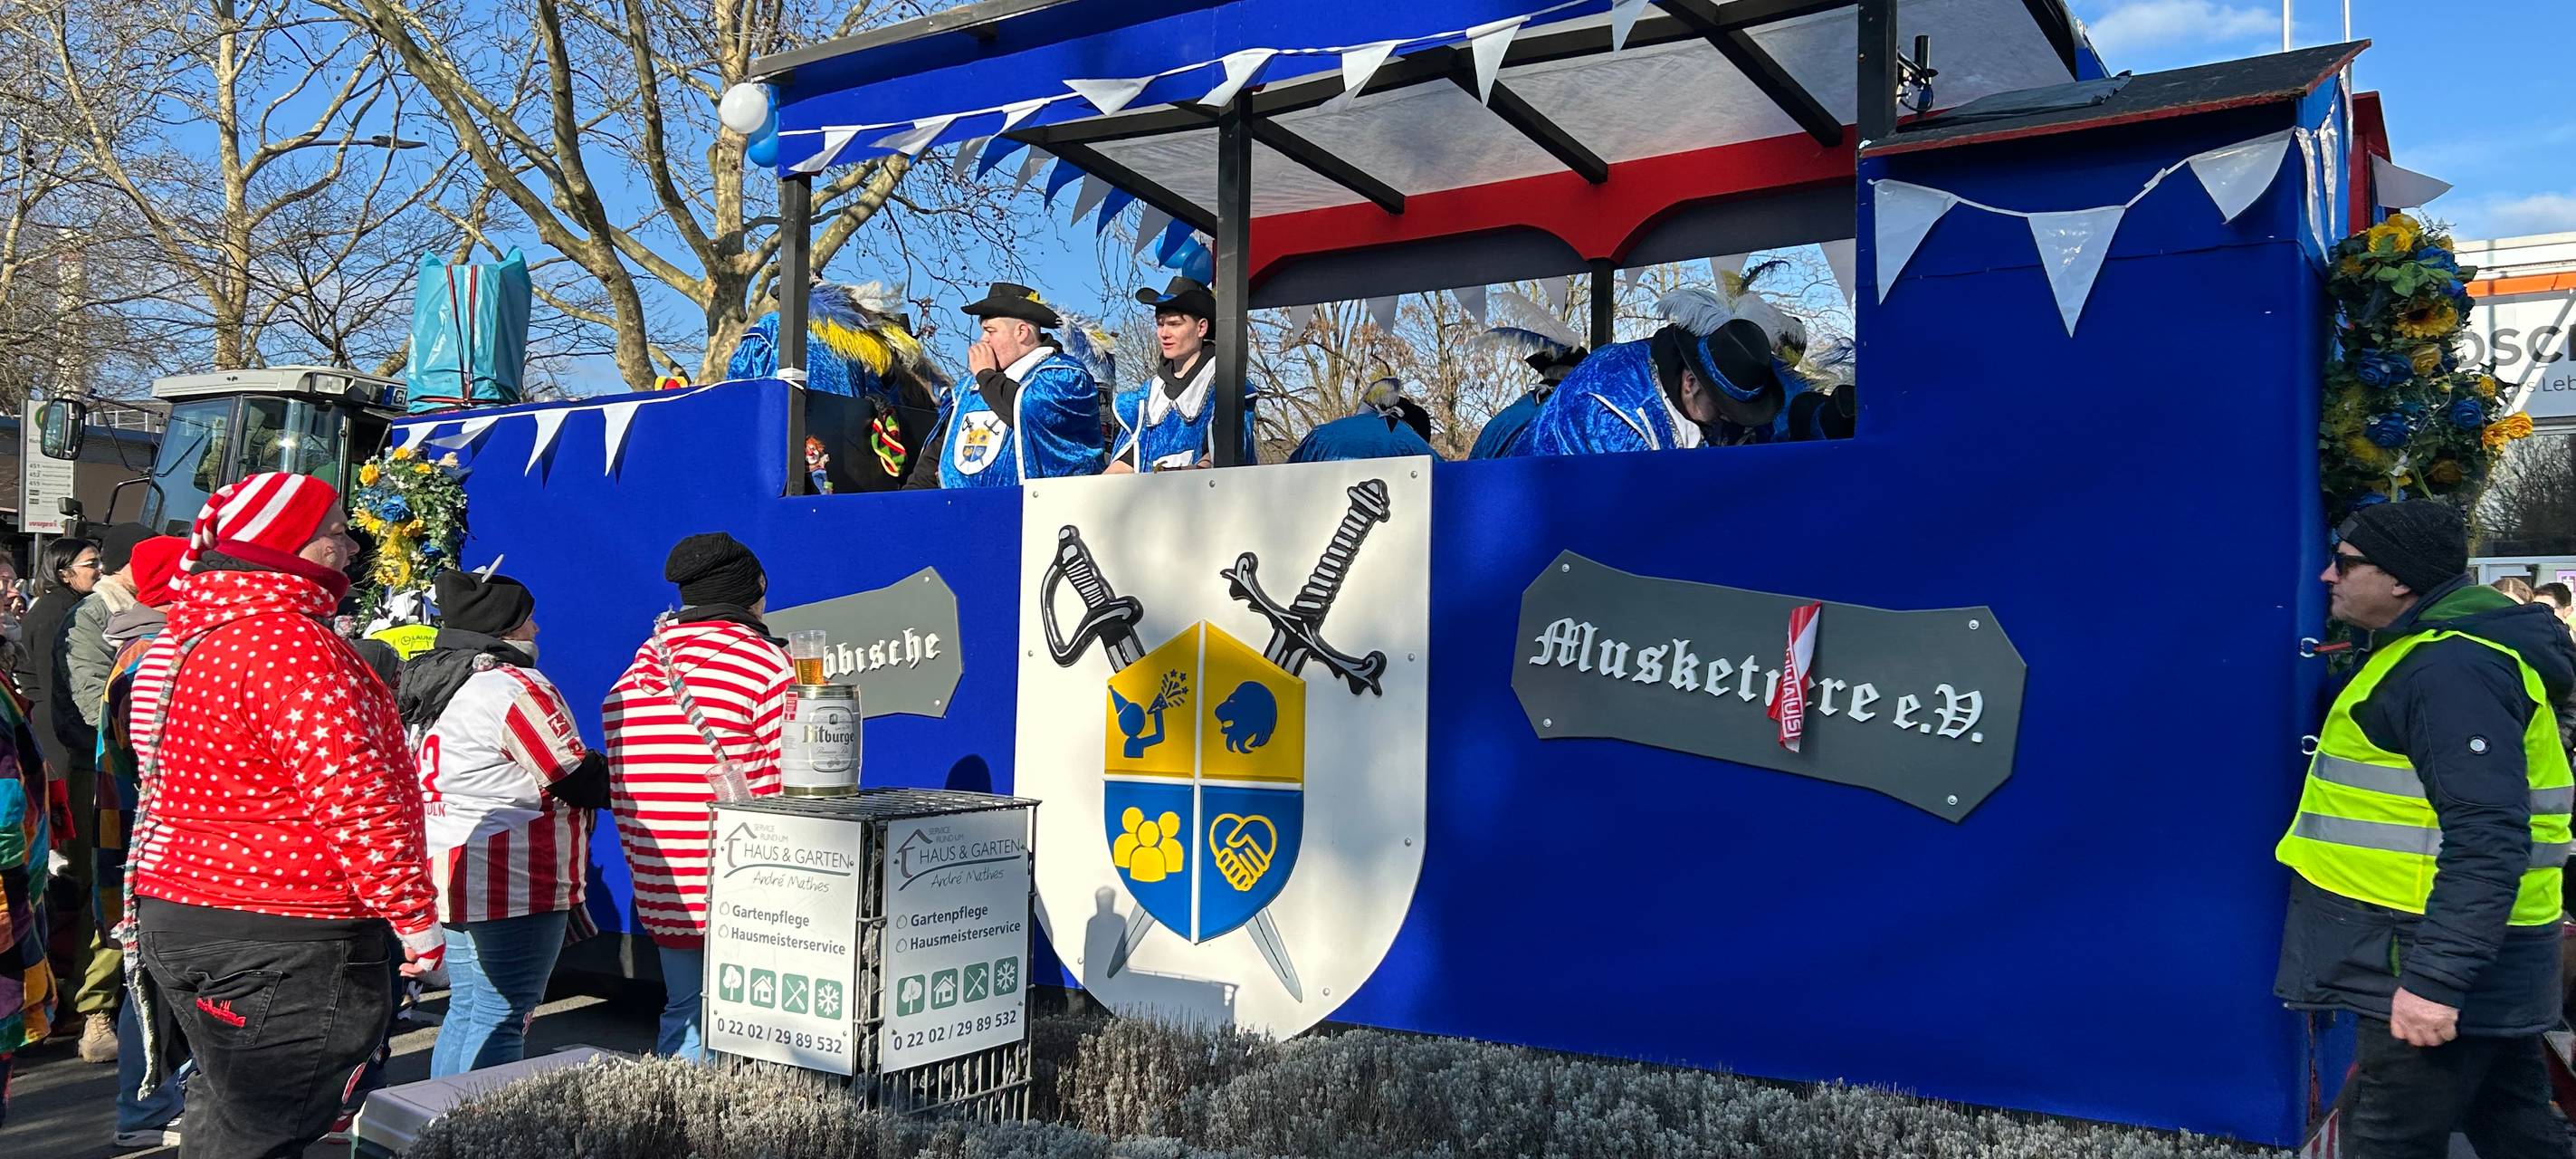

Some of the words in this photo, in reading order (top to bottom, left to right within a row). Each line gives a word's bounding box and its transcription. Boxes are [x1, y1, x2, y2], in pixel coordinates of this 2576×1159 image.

[2542, 374, 2576, 392] Leb
[823, 627, 941, 679] bbische
[1529, 617, 1882, 723] Musketire
[1893, 683, 1984, 744] e.V.
[802, 724, 854, 745] Bitburge
[744, 843, 779, 861] HAUS
[782, 848, 791, 863] &
[795, 848, 850, 869] GARTEN
[920, 845, 956, 865] HAUS
[959, 844, 968, 859] &
[971, 838, 1020, 857] GARTEN
[752, 871, 785, 887] André
[930, 871, 963, 888] André
[732, 905, 810, 929] Gartenpflege
[911, 905, 988, 927] Gartenpflege
[731, 926, 846, 955] Hausmeisterservice
[910, 921, 1021, 950] Hausmeisterservice
[717, 1018, 725, 1032] 0
[729, 1020, 743, 1036] 22
[748, 1023, 763, 1039] 02
[767, 1027, 772, 1041] /
[775, 1029, 791, 1045] 29
[796, 1032, 812, 1049] 89
[816, 1036, 843, 1054] 532
[893, 1036, 902, 1050] 0
[907, 1031, 924, 1048] 22
[929, 1027, 945, 1043] 02
[948, 1024, 954, 1039] /
[957, 1020, 972, 1037] 29
[977, 1016, 991, 1032] 89
[995, 1010, 1016, 1028] 532
